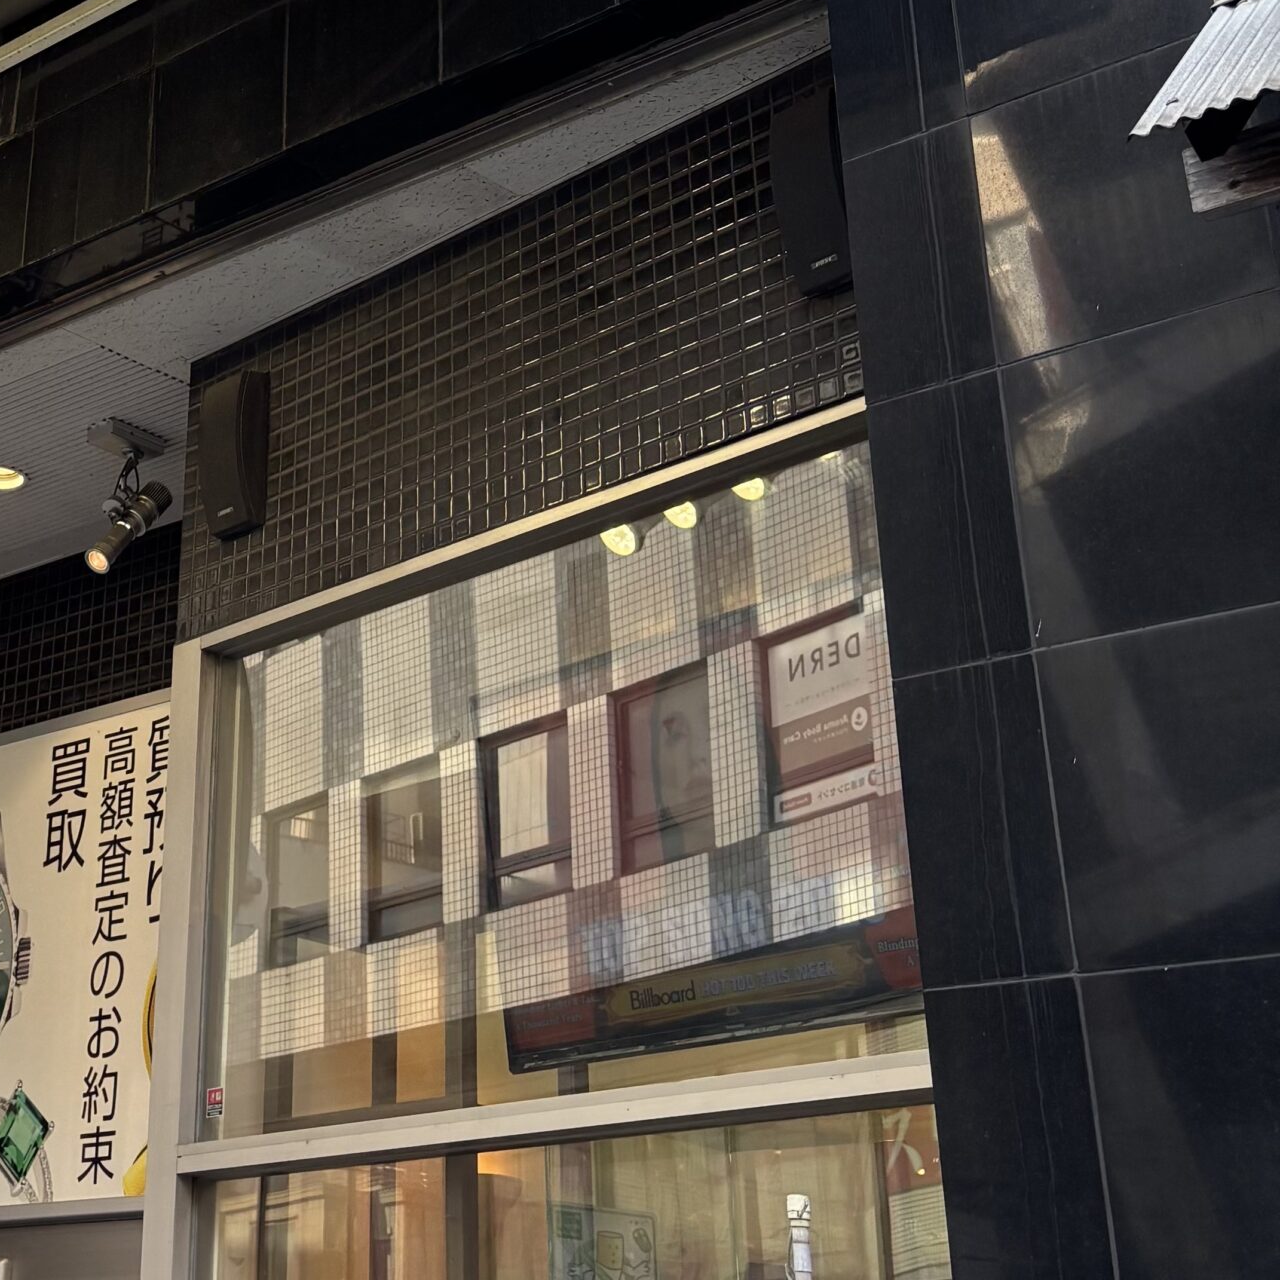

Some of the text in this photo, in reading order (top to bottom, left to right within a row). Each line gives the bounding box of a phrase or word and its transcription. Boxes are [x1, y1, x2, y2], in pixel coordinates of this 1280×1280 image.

[42, 736, 91, 874] 買取
[77, 725, 138, 1185] 高額査定のお約束
[630, 980, 696, 1010] Billboard
